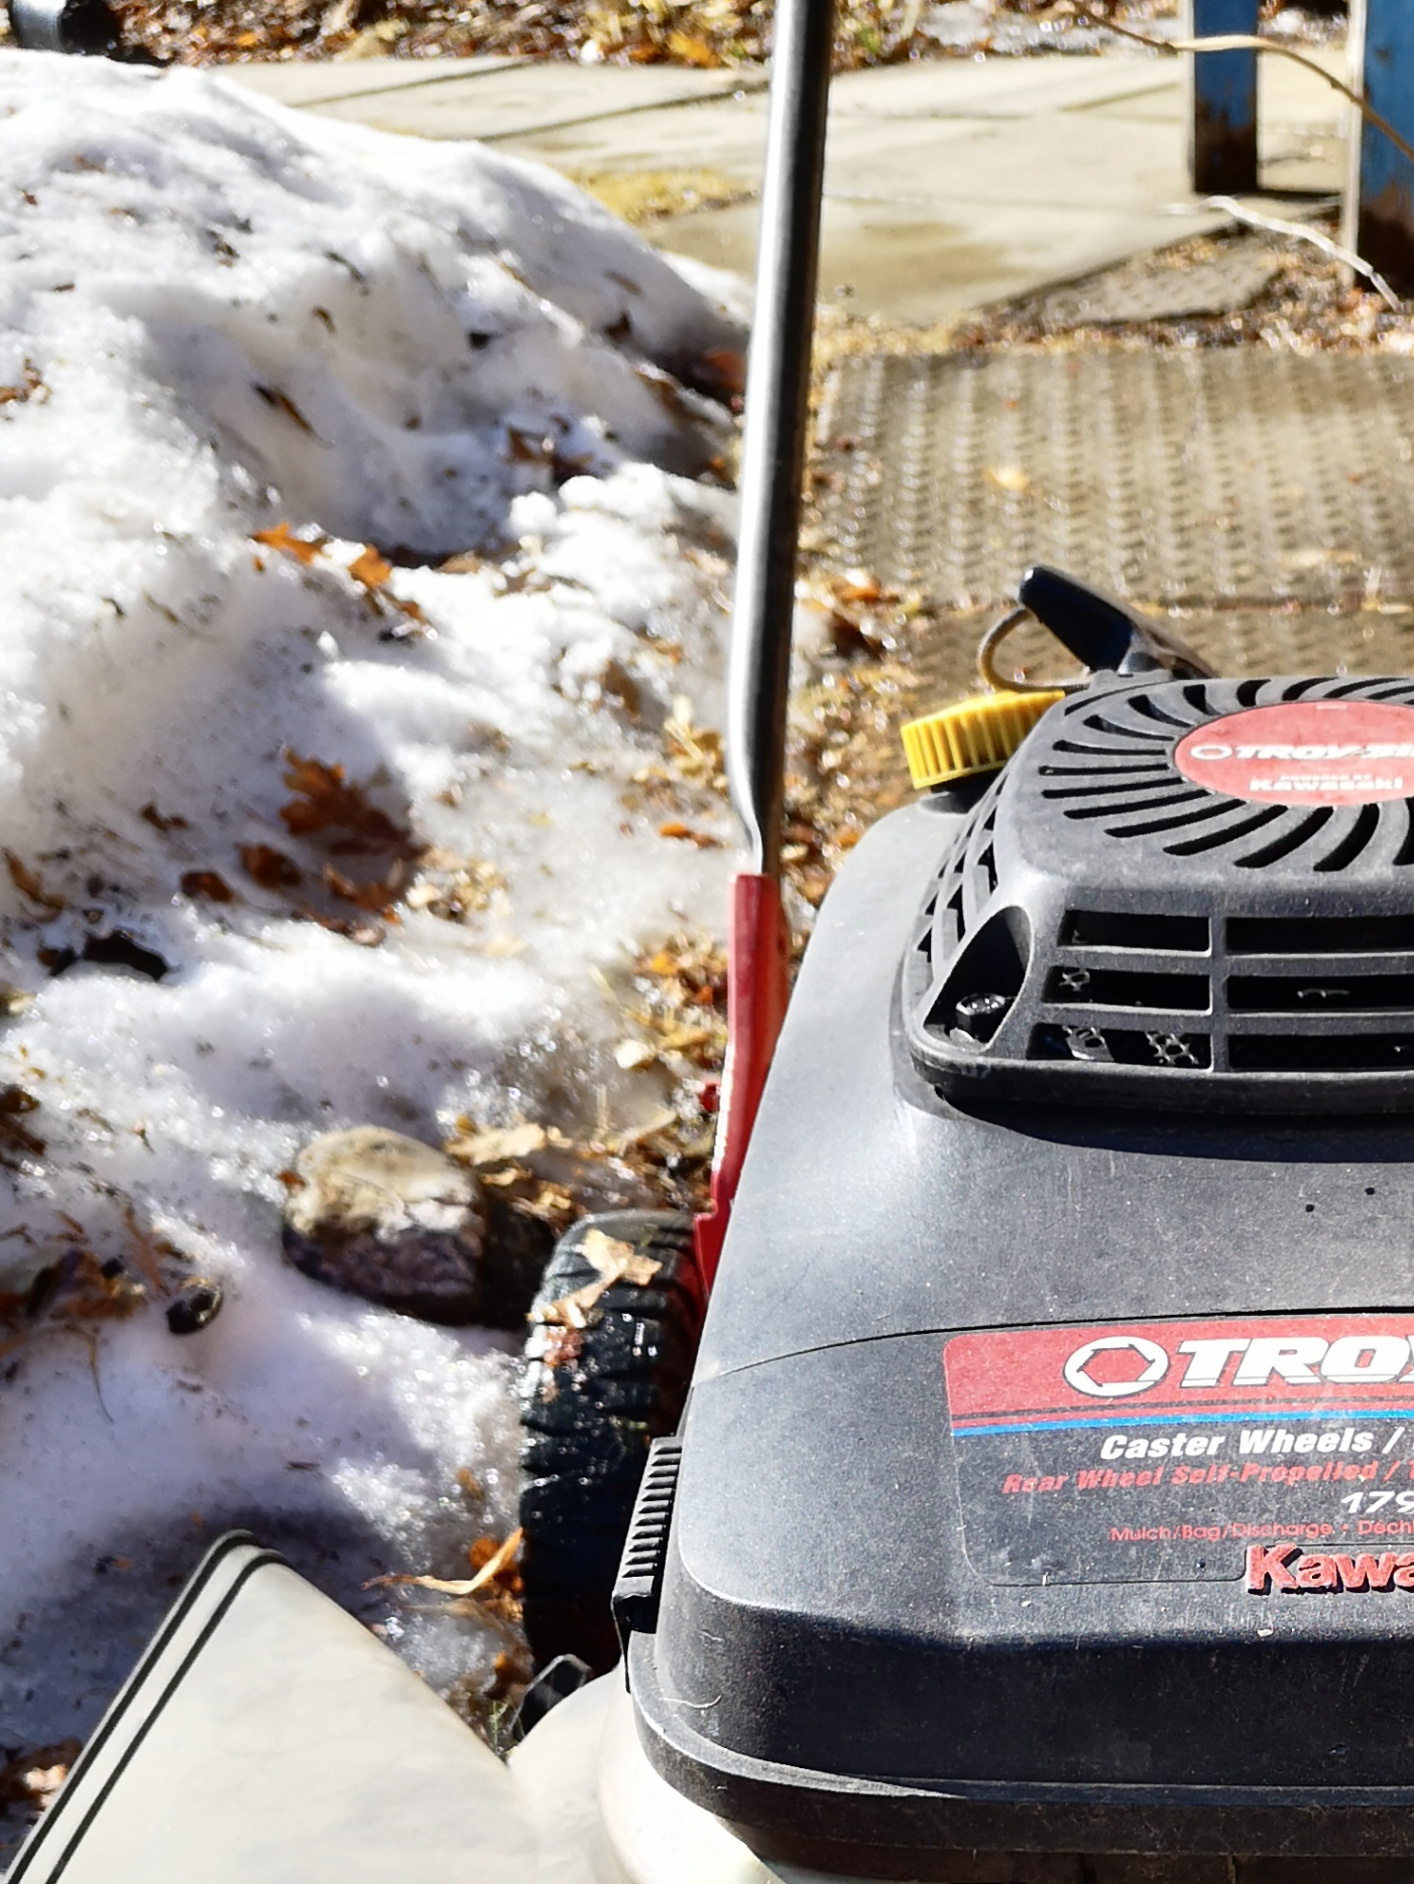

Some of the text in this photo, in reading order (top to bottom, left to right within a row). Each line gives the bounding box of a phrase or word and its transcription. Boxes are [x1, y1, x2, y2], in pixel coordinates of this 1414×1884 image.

[1250, 776, 1403, 791] Kawasaki
[1100, 1433, 1226, 1459] Caster
[1239, 1427, 1374, 1454] Wheels
[1002, 1474, 1069, 1493] Rear
[1077, 1466, 1164, 1490] Wheel
[1170, 1460, 1380, 1486] Self-Propelled
